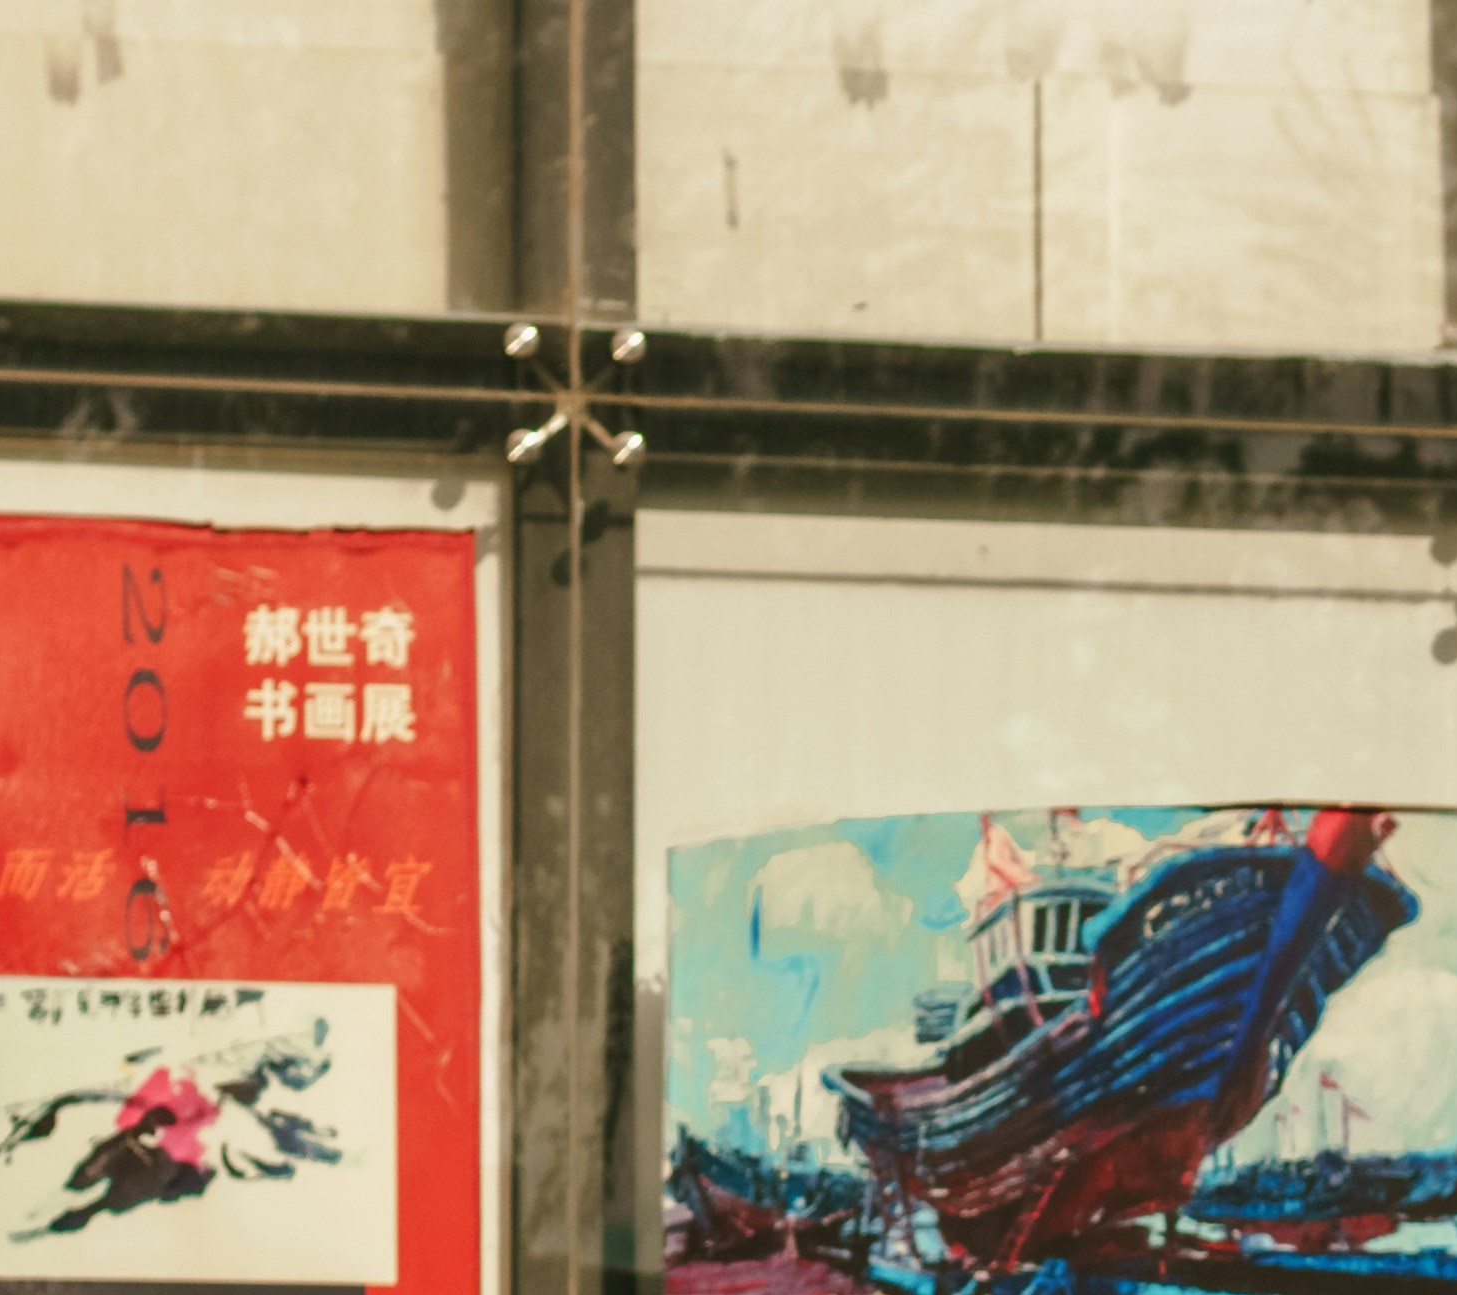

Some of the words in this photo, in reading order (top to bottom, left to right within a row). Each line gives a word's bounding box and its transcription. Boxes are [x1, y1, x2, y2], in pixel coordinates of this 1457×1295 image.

[243, 603, 416, 670] 郝世奇
[244, 677, 416, 744] 书画展
